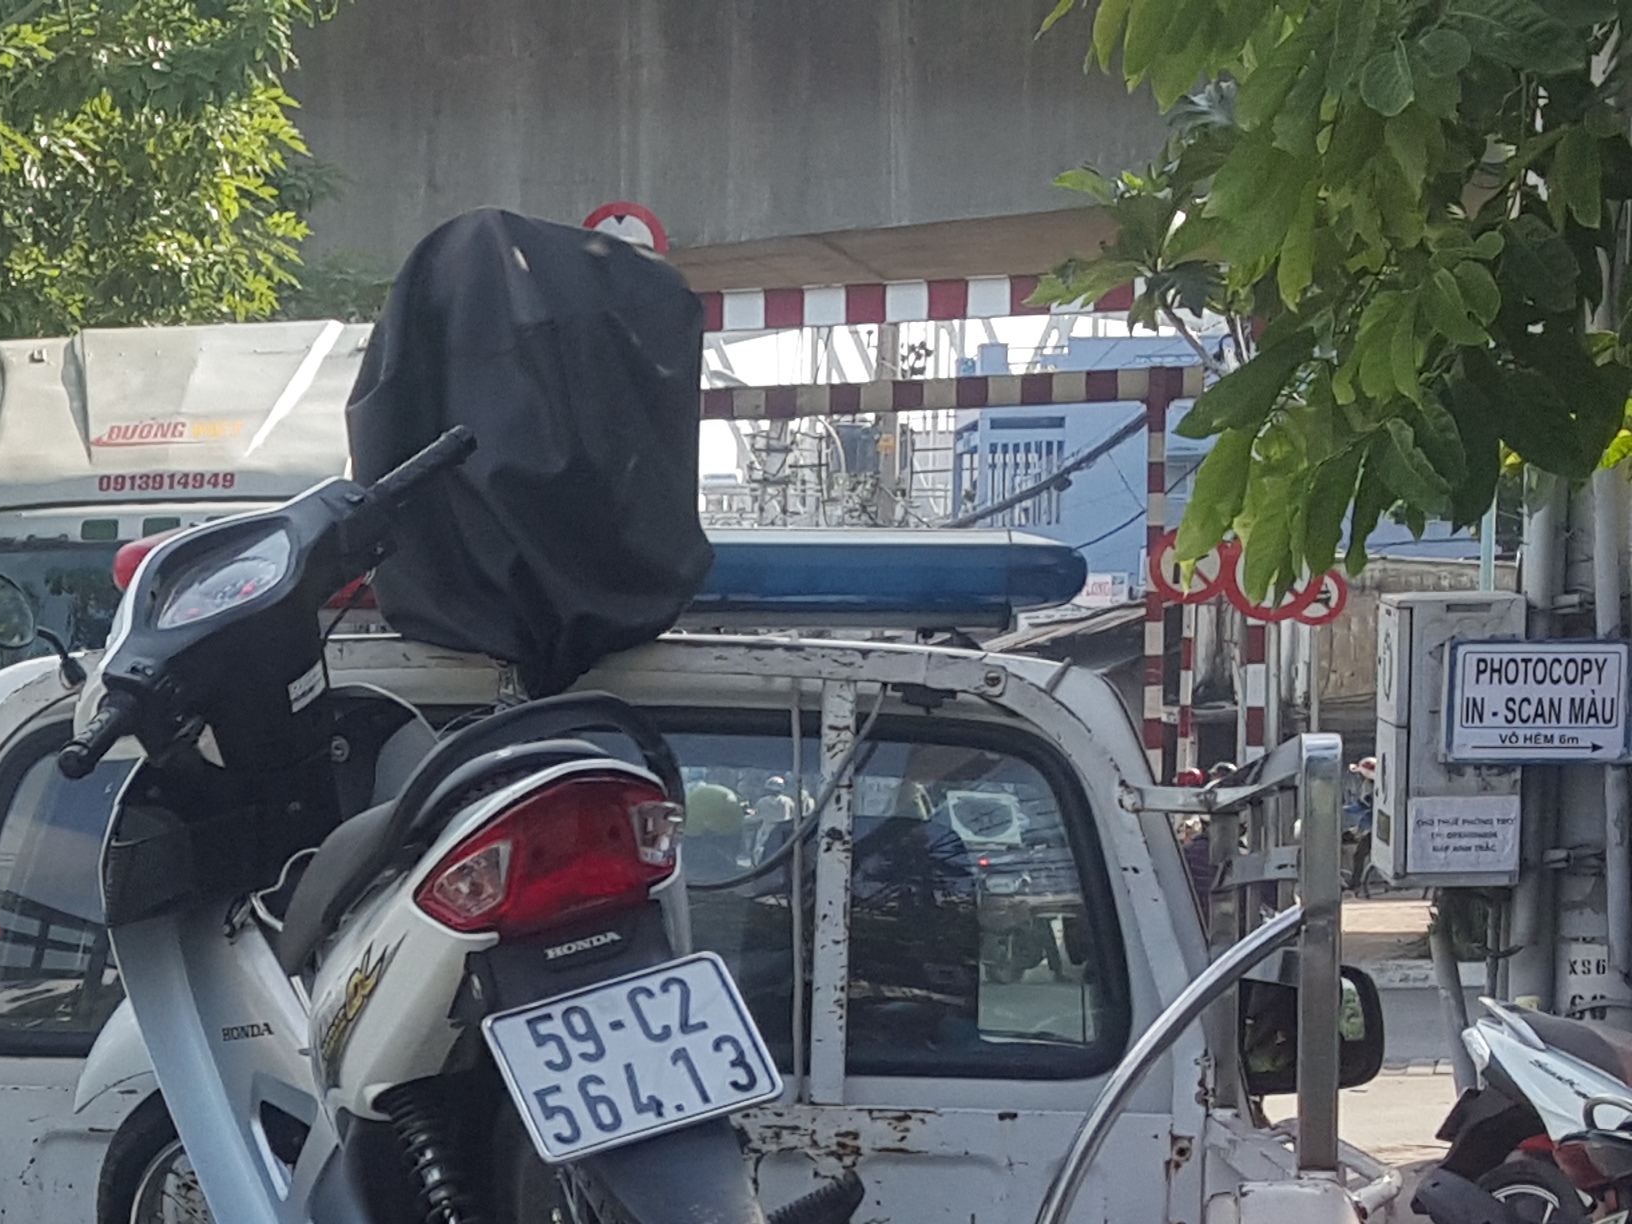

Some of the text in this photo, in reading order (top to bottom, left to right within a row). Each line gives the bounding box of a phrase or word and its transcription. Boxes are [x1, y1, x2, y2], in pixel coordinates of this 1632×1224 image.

[98, 472, 236, 492] 0913914949
[1475, 657, 1608, 686] PHOTOCOPY
[1465, 697, 1485, 724] IN
[1504, 697, 1562, 724] SCAN
[1569, 689, 1615, 724] MÀU
[544, 931, 622, 960] HONDA
[222, 1022, 274, 1041] HONDA
[526, 976, 709, 1073] 59-C2
[533, 1034, 758, 1145] 564.13
